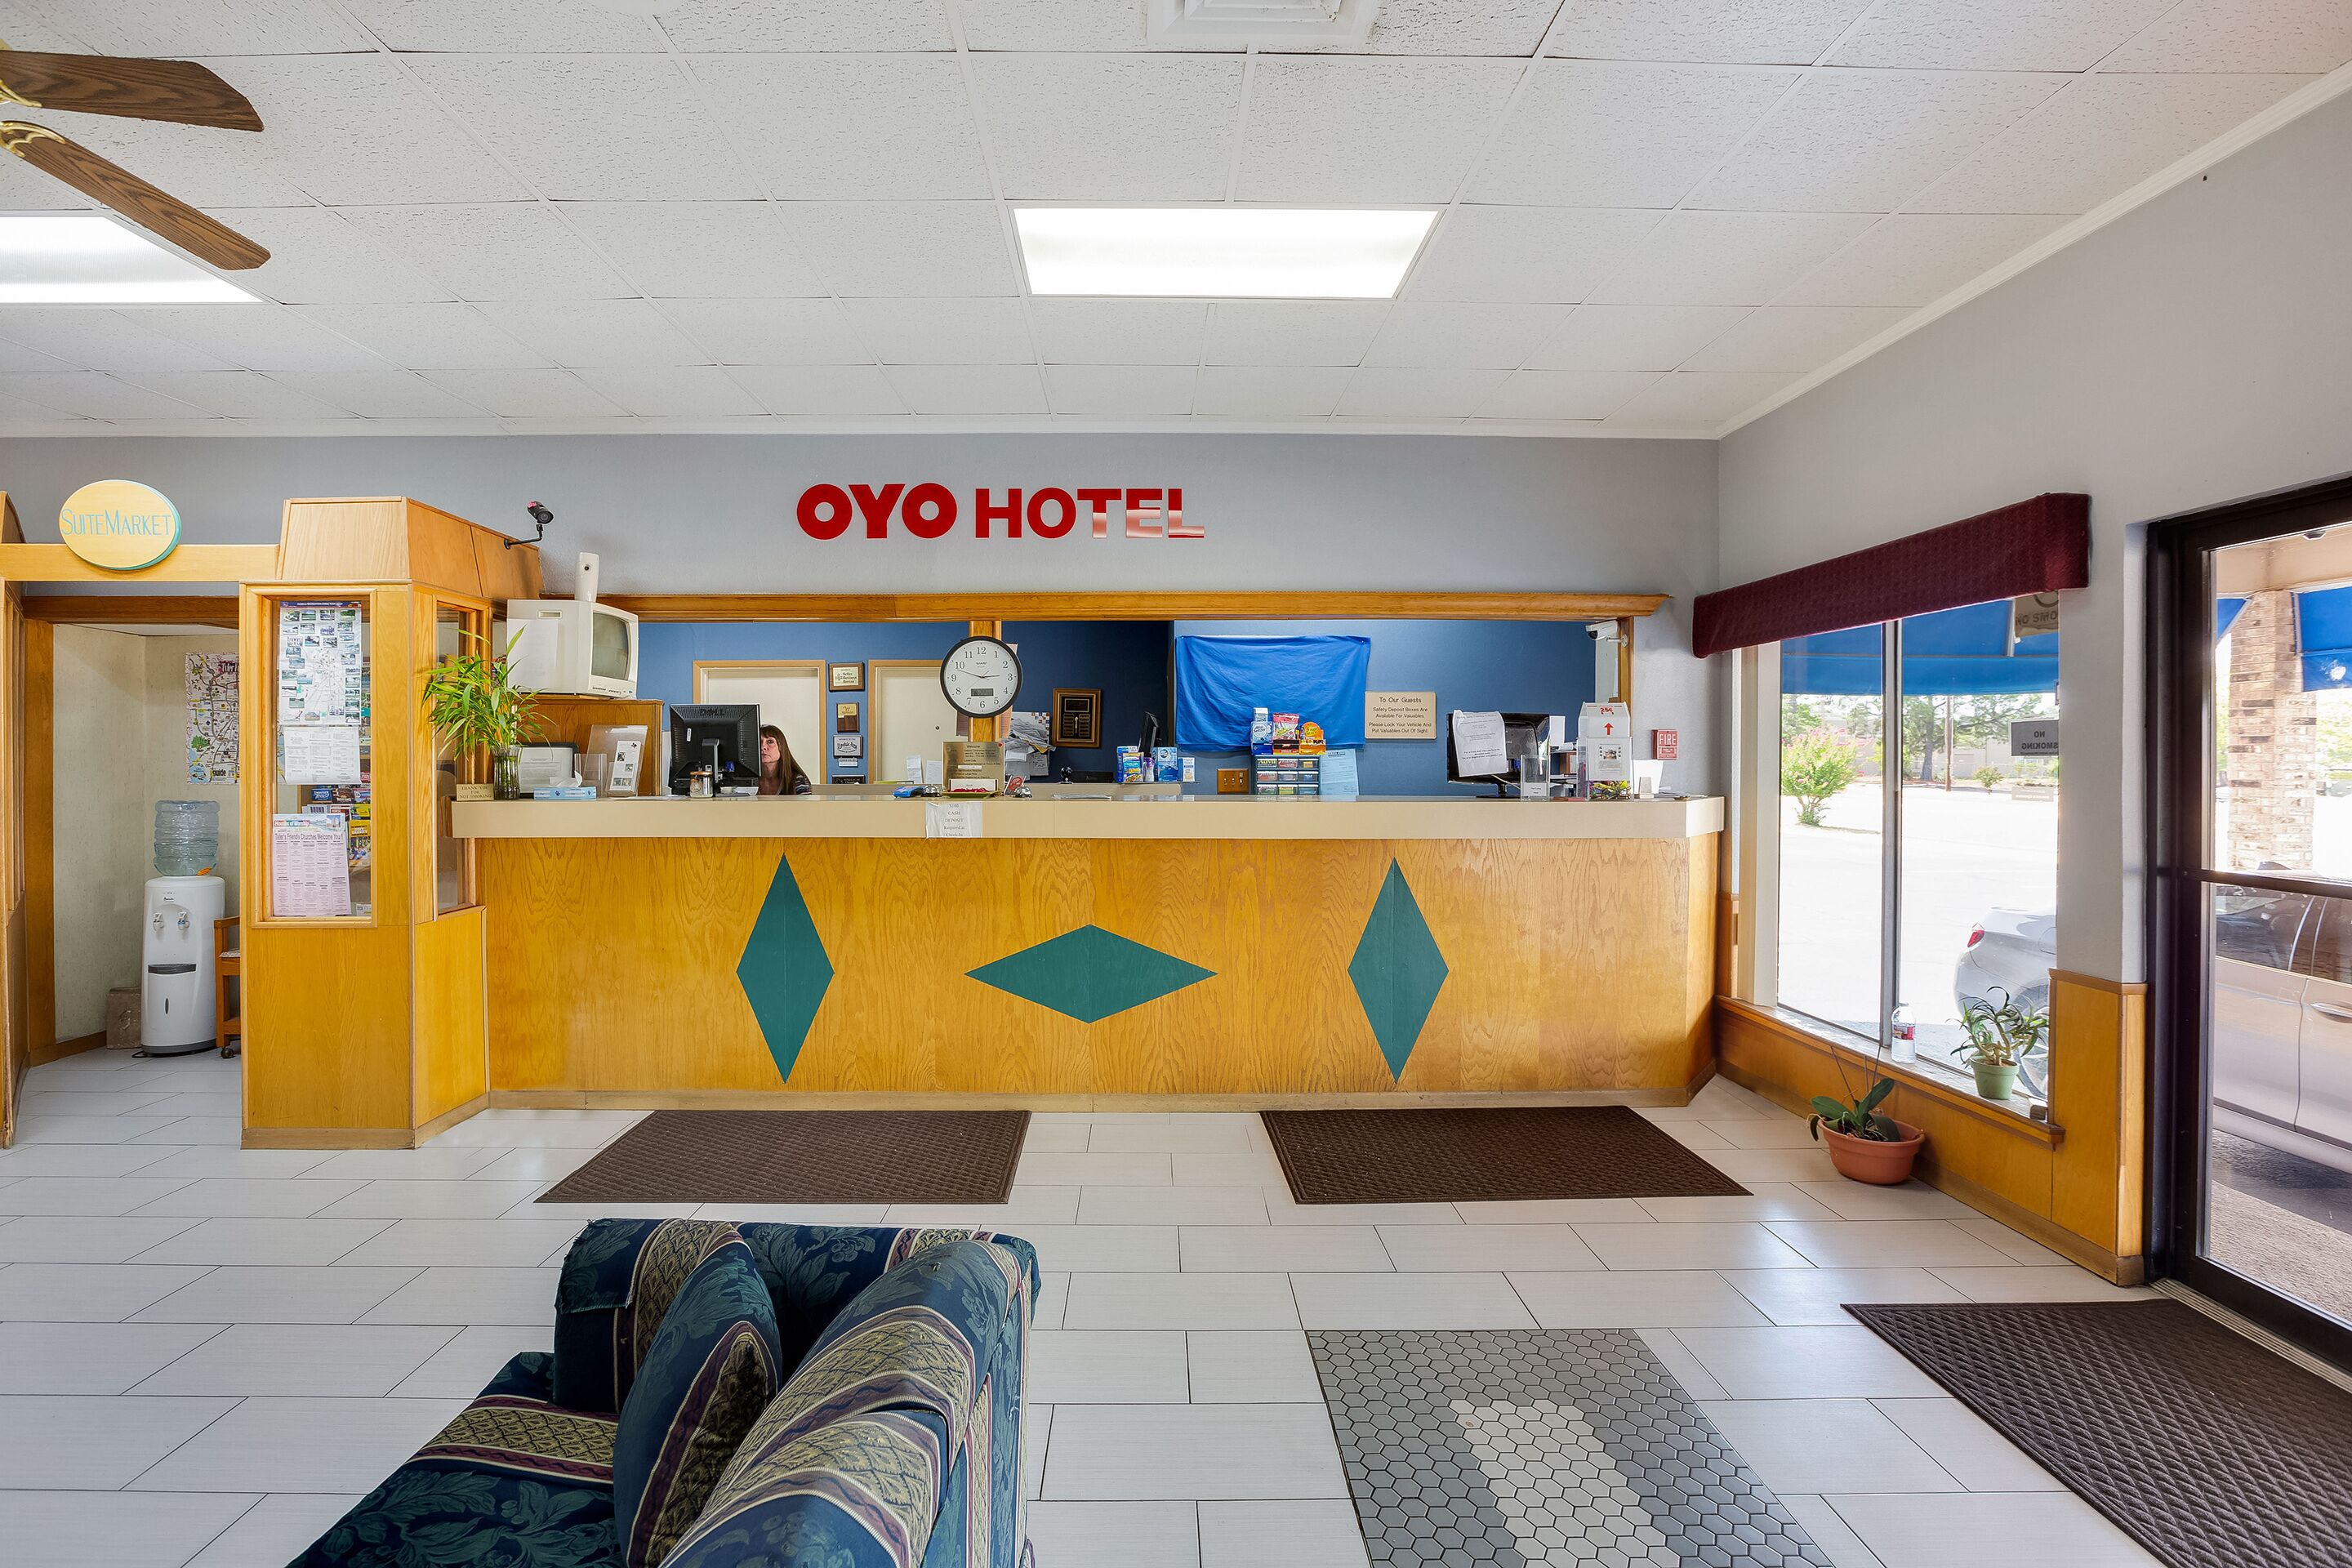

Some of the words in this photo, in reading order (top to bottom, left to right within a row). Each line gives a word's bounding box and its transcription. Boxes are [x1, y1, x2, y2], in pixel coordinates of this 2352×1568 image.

[796, 483, 958, 540] OYO
[975, 488, 1205, 539] HOTEL
[2033, 610, 2058, 622] SMO
[964, 651, 973, 659] 11
[951, 674, 956, 682] 9
[1007, 673, 1013, 681] 3
[956, 687, 961, 695] 8
[1659, 733, 1677, 745] FIRE
[212, 768, 226, 777] guide
